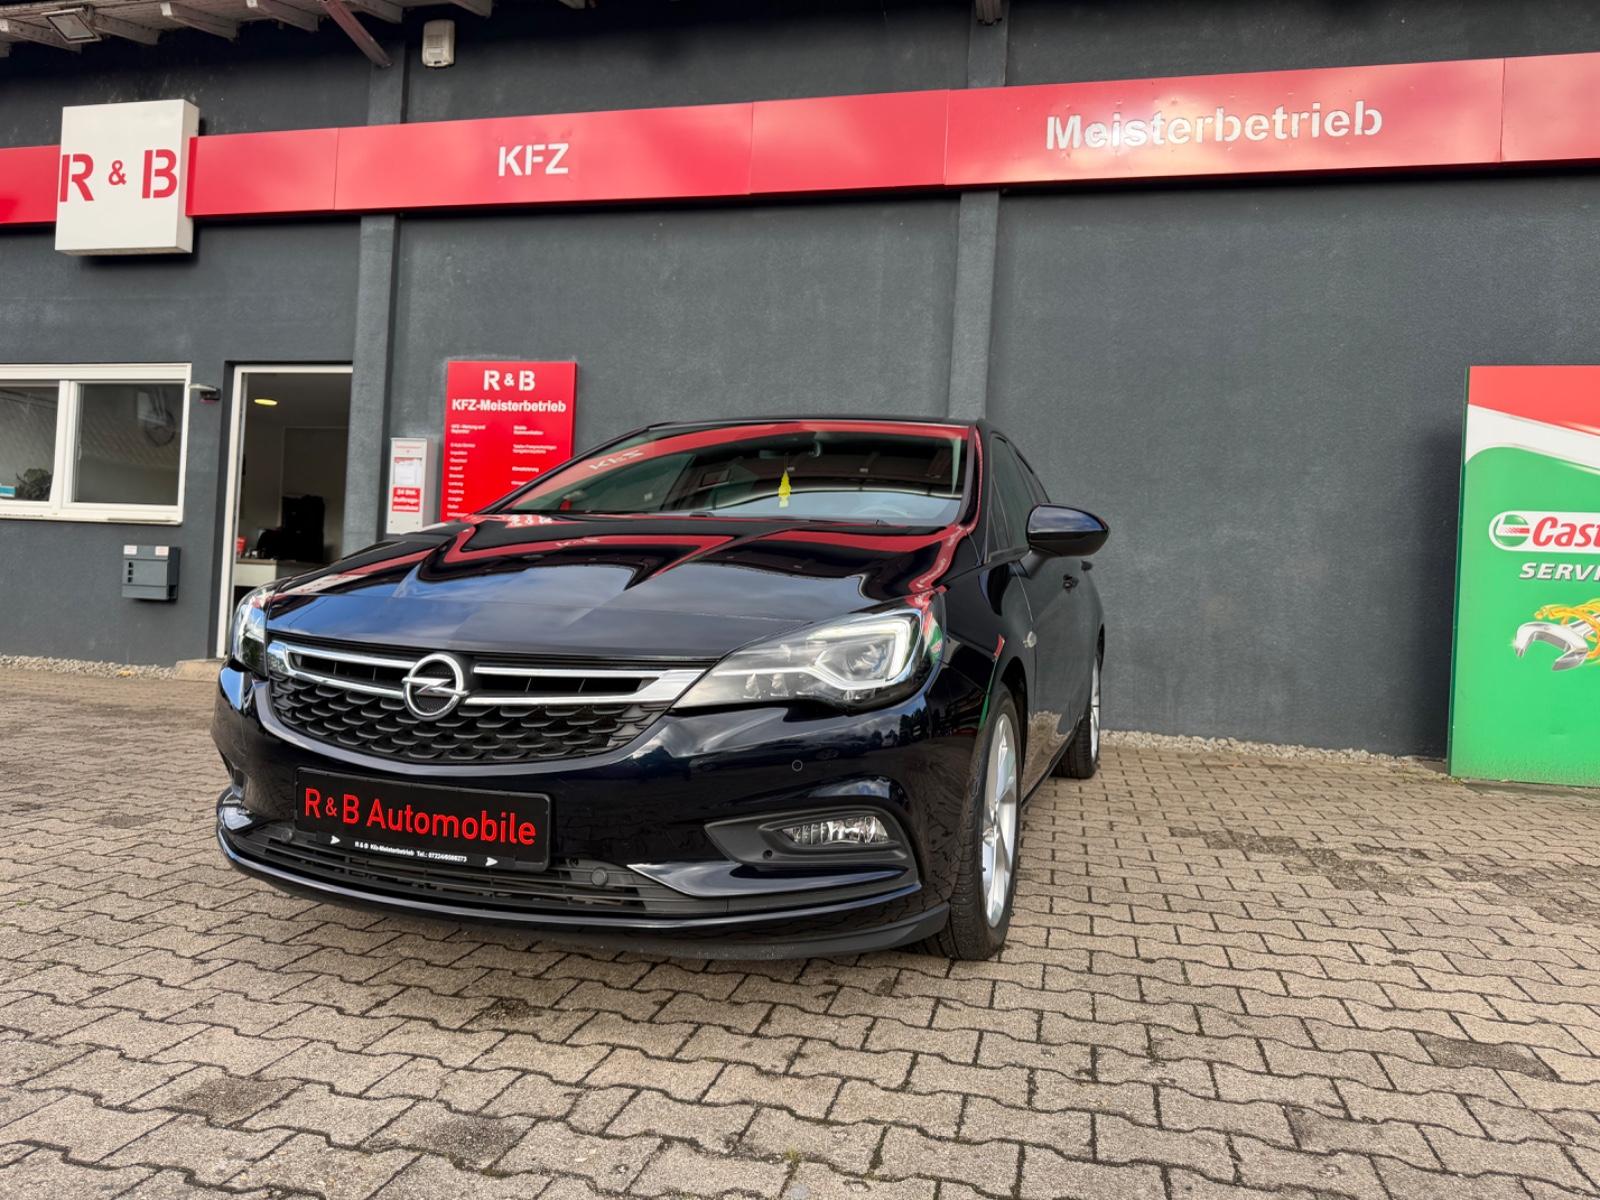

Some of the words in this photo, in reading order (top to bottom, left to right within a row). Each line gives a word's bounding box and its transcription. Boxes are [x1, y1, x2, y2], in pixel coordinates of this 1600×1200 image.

[1046, 100, 1383, 150] Meisterbetrieb
[59, 153, 95, 202] R
[108, 160, 127, 186] &
[142, 149, 178, 199] B
[498, 142, 569, 177] KFZ
[483, 370, 500, 391] R
[504, 373, 514, 387] &
[519, 371, 535, 391] B
[452, 398, 567, 413] KFZ-Meisterbetrieb
[305, 788, 321, 819] R
[325, 797, 337, 817] &
[342, 794, 360, 824] B
[366, 799, 537, 845] Automobile
